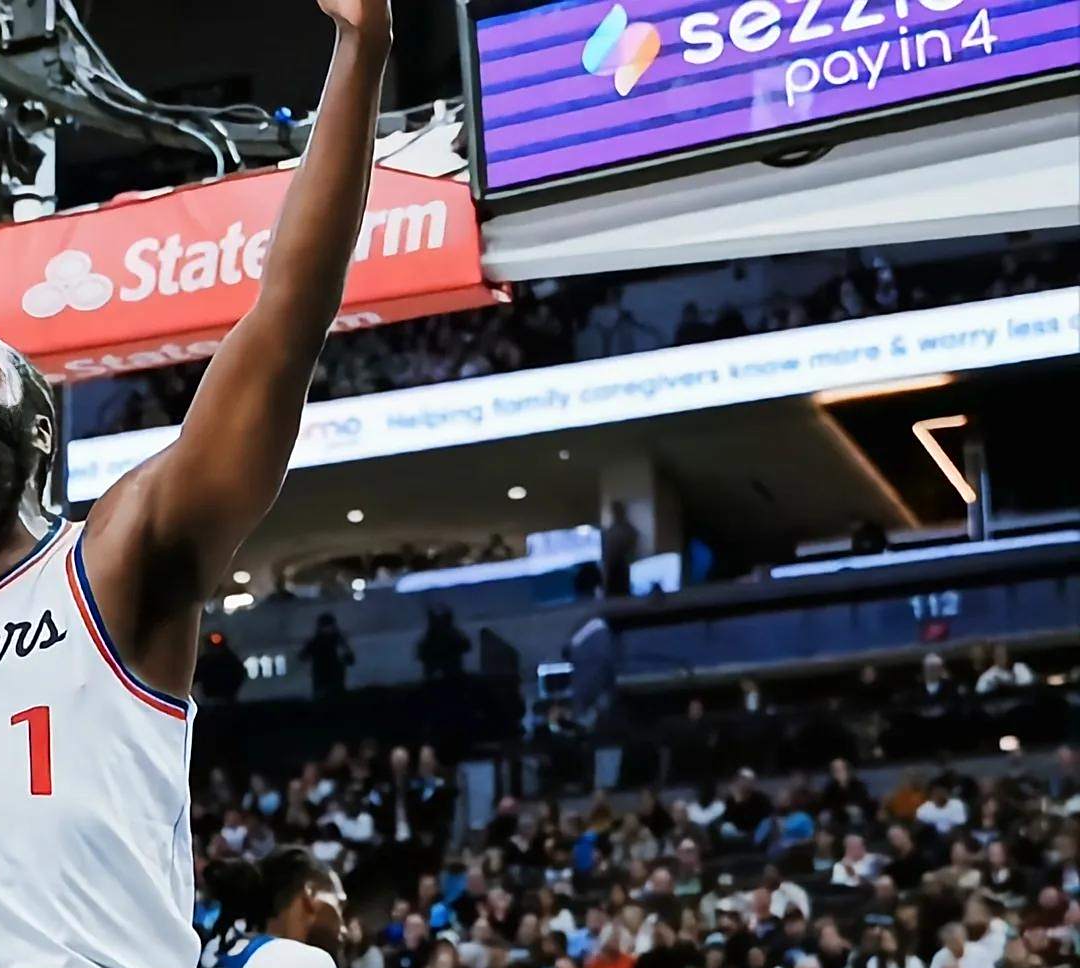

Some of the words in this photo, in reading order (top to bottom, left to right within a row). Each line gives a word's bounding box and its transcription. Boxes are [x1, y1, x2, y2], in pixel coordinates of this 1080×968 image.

[680, 0, 967, 64] sezz
[785, 41, 890, 107] pay
[899, 27, 952, 71] in
[961, 8, 999, 55] 4
[353, 200, 447, 262] rm
[10, 705, 53, 796] 1
